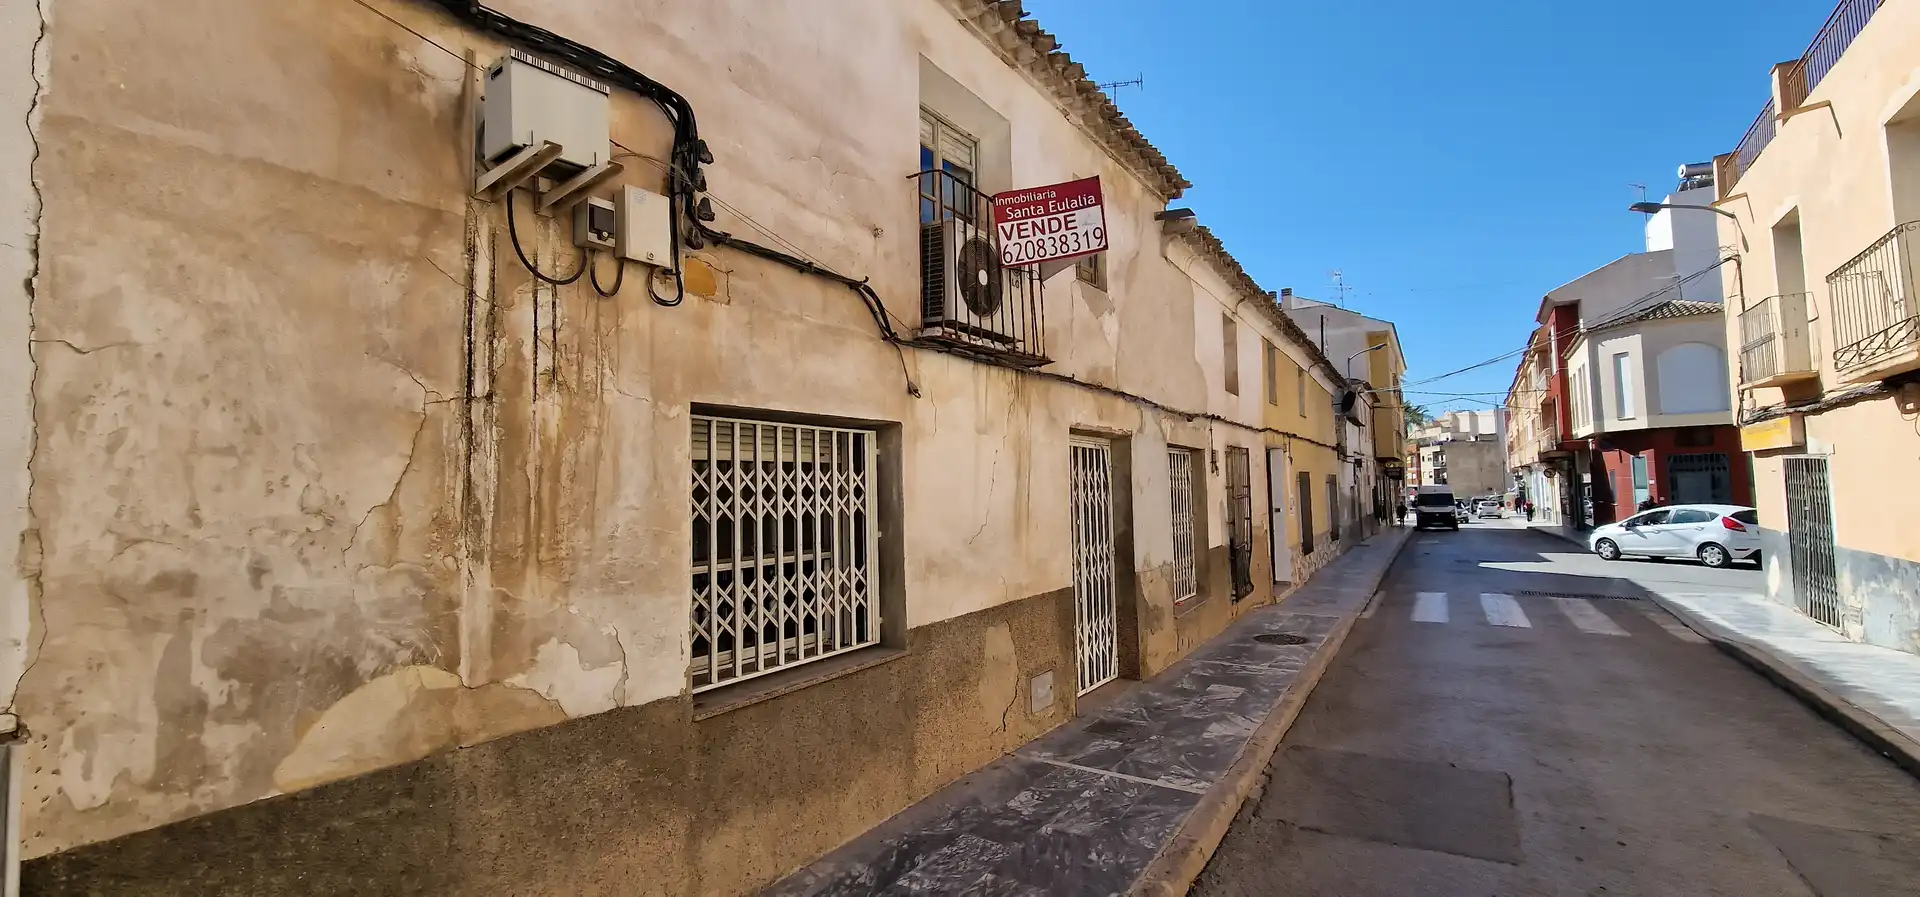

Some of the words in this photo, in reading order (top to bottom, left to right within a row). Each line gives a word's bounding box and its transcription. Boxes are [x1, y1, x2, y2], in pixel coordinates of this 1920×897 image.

[995, 190, 1057, 207] Inmobiliaria
[1006, 205, 1045, 220] Santa
[1049, 194, 1096, 213] Eulalia
[1000, 213, 1078, 241] VENDE
[1003, 227, 1104, 263] 620838319
